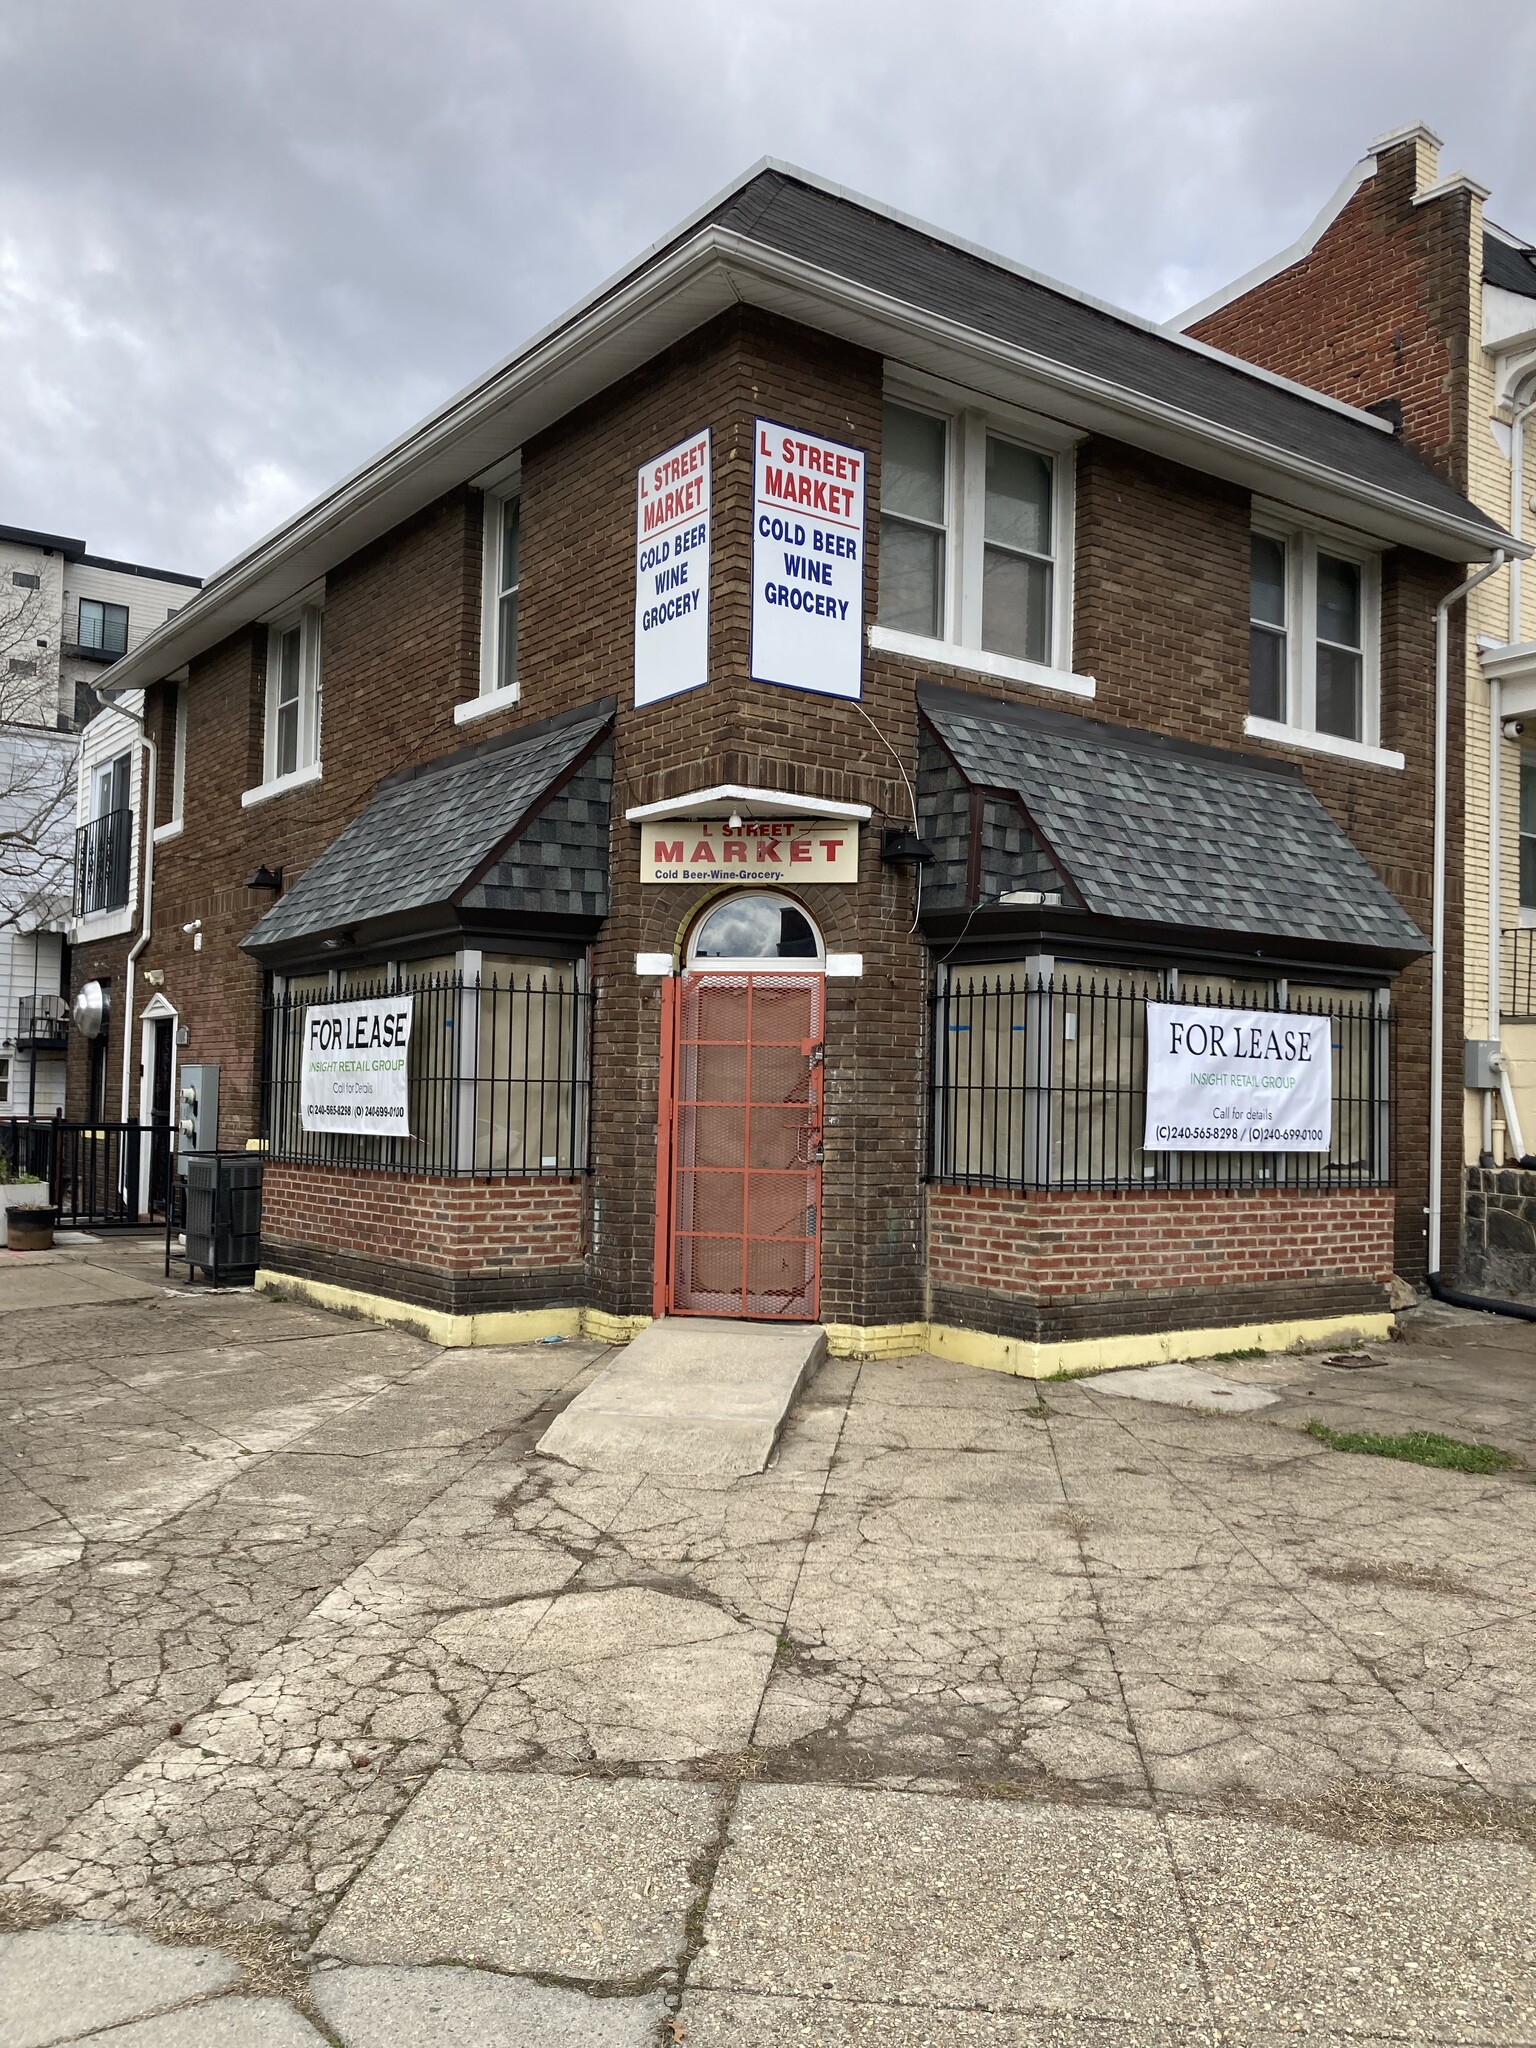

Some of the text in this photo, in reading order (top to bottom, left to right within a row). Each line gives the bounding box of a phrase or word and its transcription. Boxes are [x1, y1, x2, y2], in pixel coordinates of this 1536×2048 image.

[640, 440, 707, 499] L STREET
[760, 431, 861, 483] L STREET
[643, 475, 704, 532] MARKET
[765, 465, 854, 517] MARKET
[640, 522, 707, 572] COLD BEER
[758, 515, 857, 560] COLD BEER
[655, 561, 689, 595] WINE
[783, 552, 833, 586] WINE
[643, 588, 700, 631] GROCERY
[764, 581, 849, 621] GROCERY
[703, 823, 795, 837] L STREET
[654, 840, 844, 863] MARKET
[655, 870, 679, 879] Cold
[310, 1012, 408, 1051] FOR LEASE
[1169, 1022, 1312, 1062] FOR LEASE
[309, 1059, 405, 1073] INSIGHT RETAIL GROUP
[1190, 1072, 1296, 1089] INSIGHT RETAIL GROUP
[333, 1082, 345, 1094] Call
[346, 1082, 354, 1094] for
[1213, 1106, 1273, 1121] Call for details
